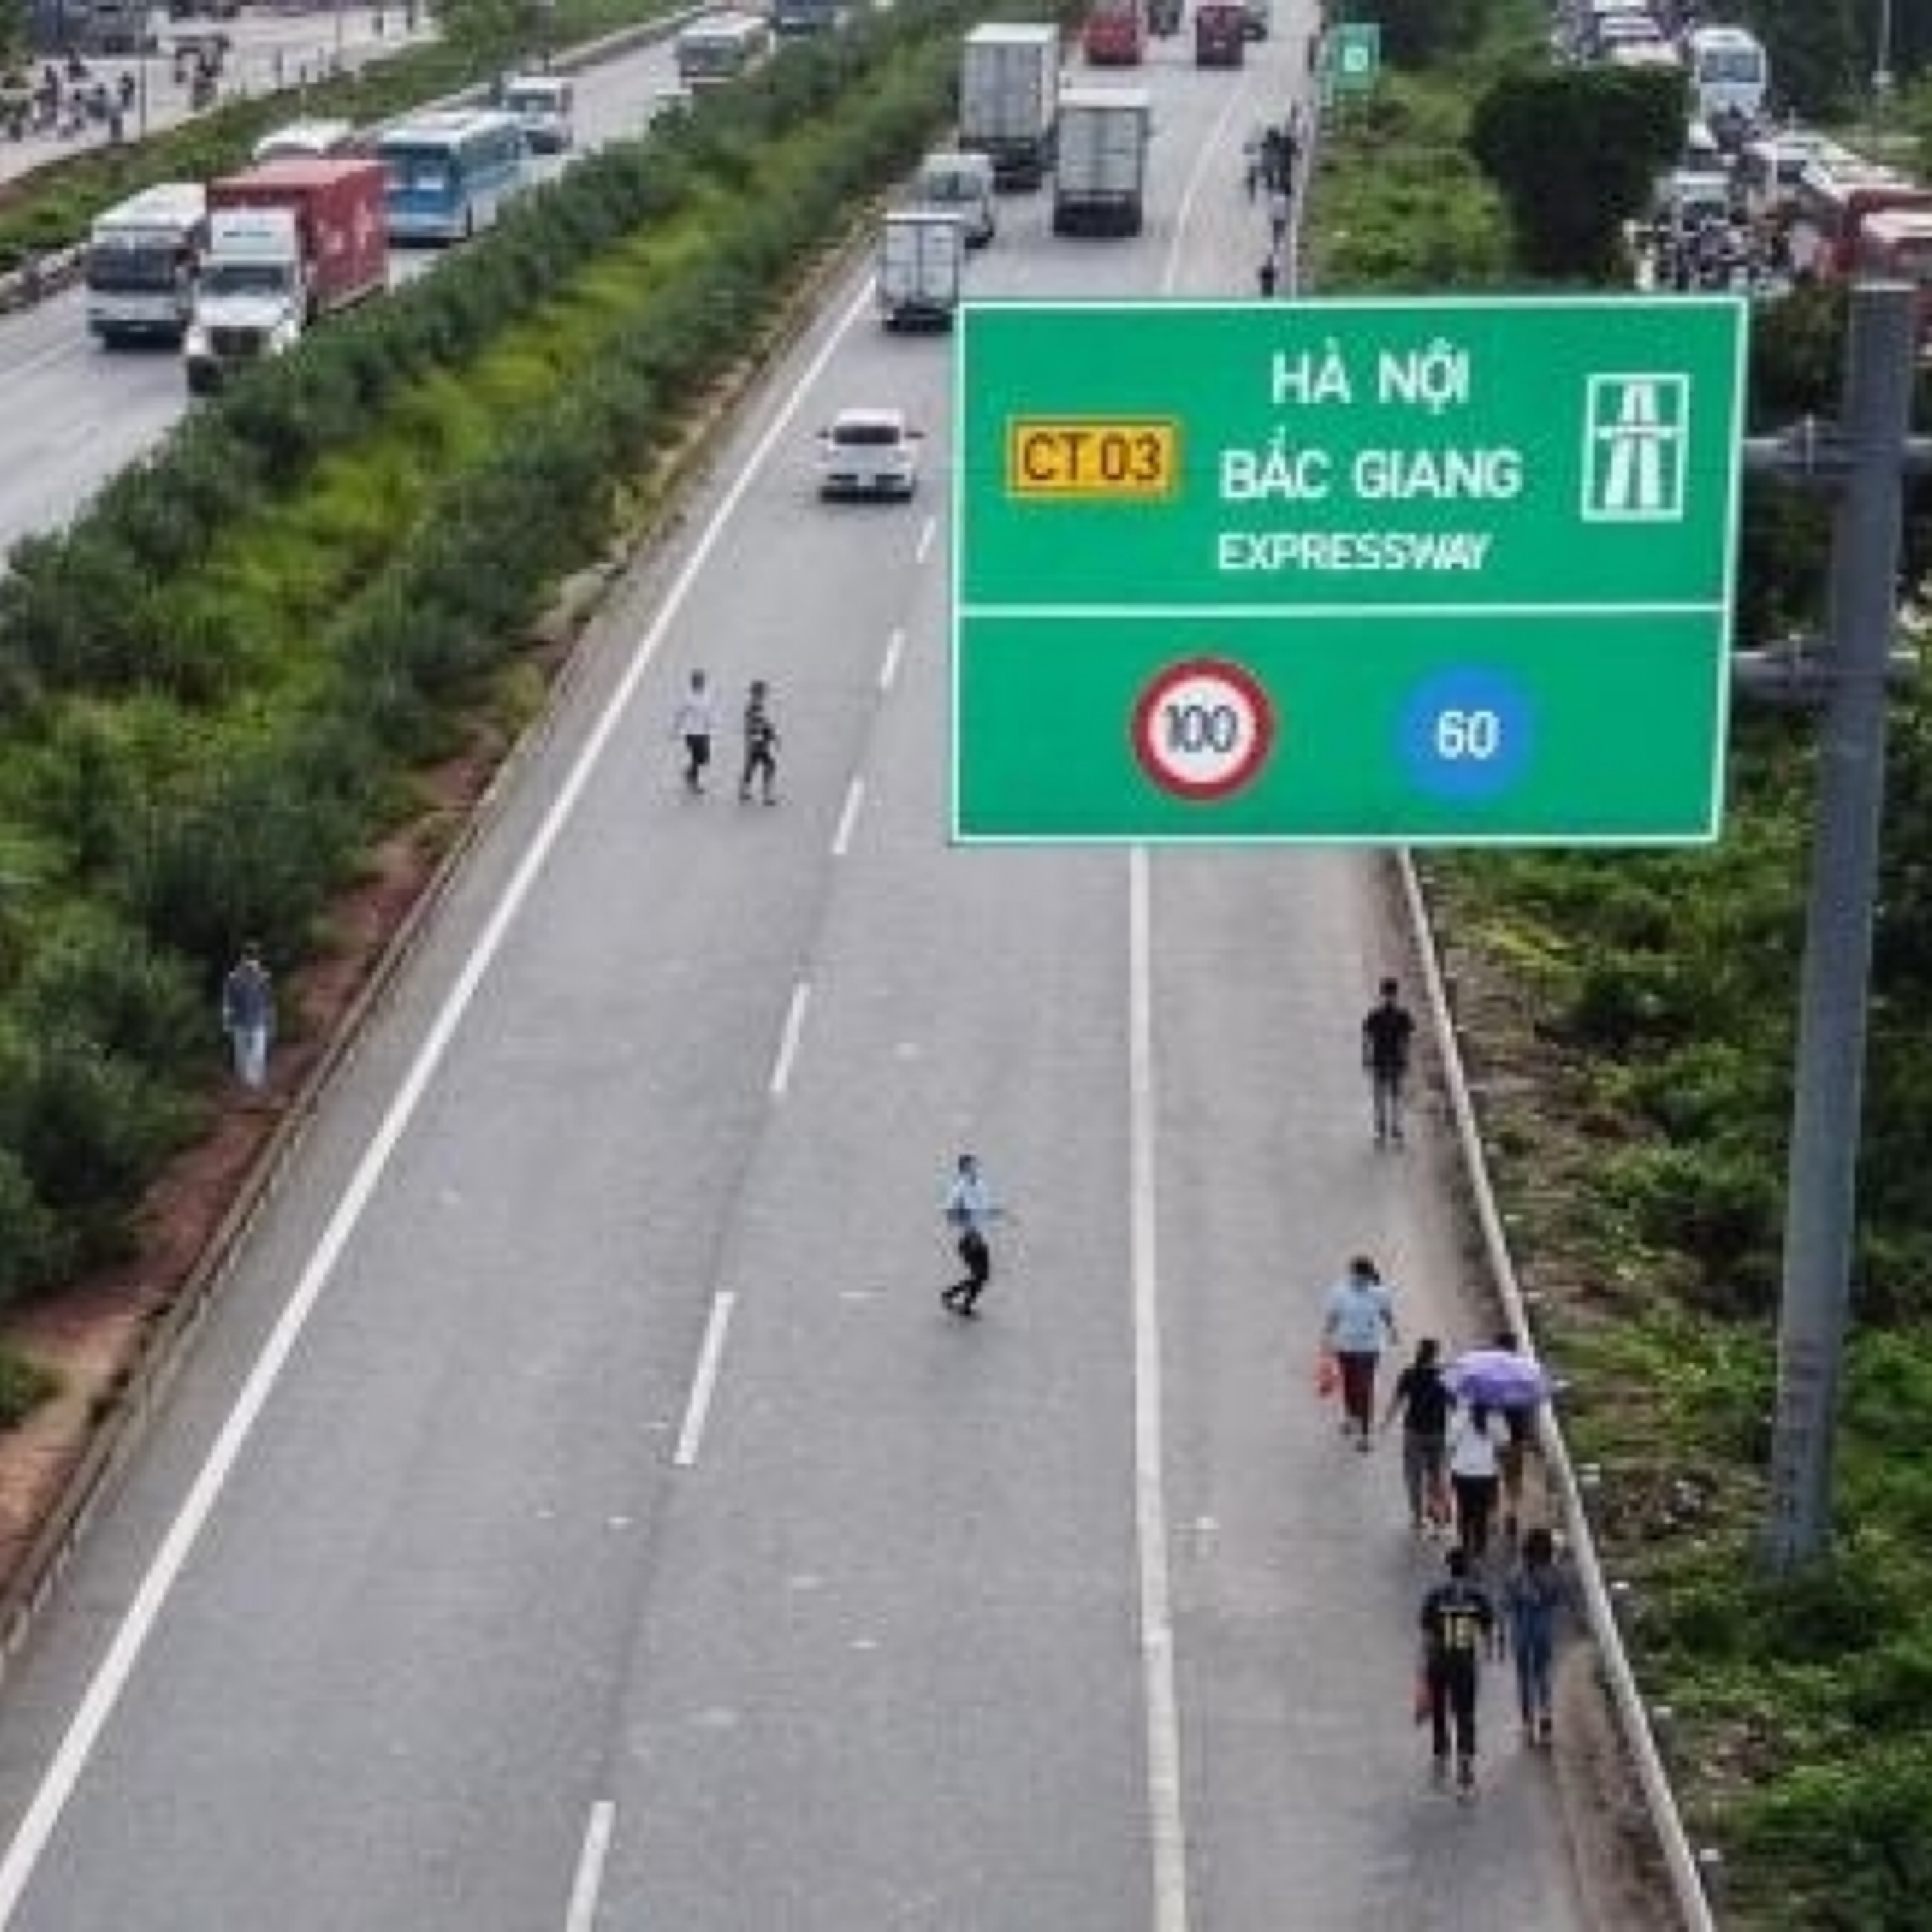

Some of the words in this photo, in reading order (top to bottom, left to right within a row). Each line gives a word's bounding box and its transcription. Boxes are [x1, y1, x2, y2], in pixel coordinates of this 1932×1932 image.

[1273, 337, 1352, 404] HÀ
[1378, 337, 1470, 415] NỘI
[1023, 432, 1091, 481] CT
[1101, 432, 1161, 481] 03
[1354, 449, 1524, 498] GIANG
[1218, 533, 1492, 571] EXPRESSWAY
[1164, 706, 1238, 753] 100
[1436, 710, 1499, 759] 60
